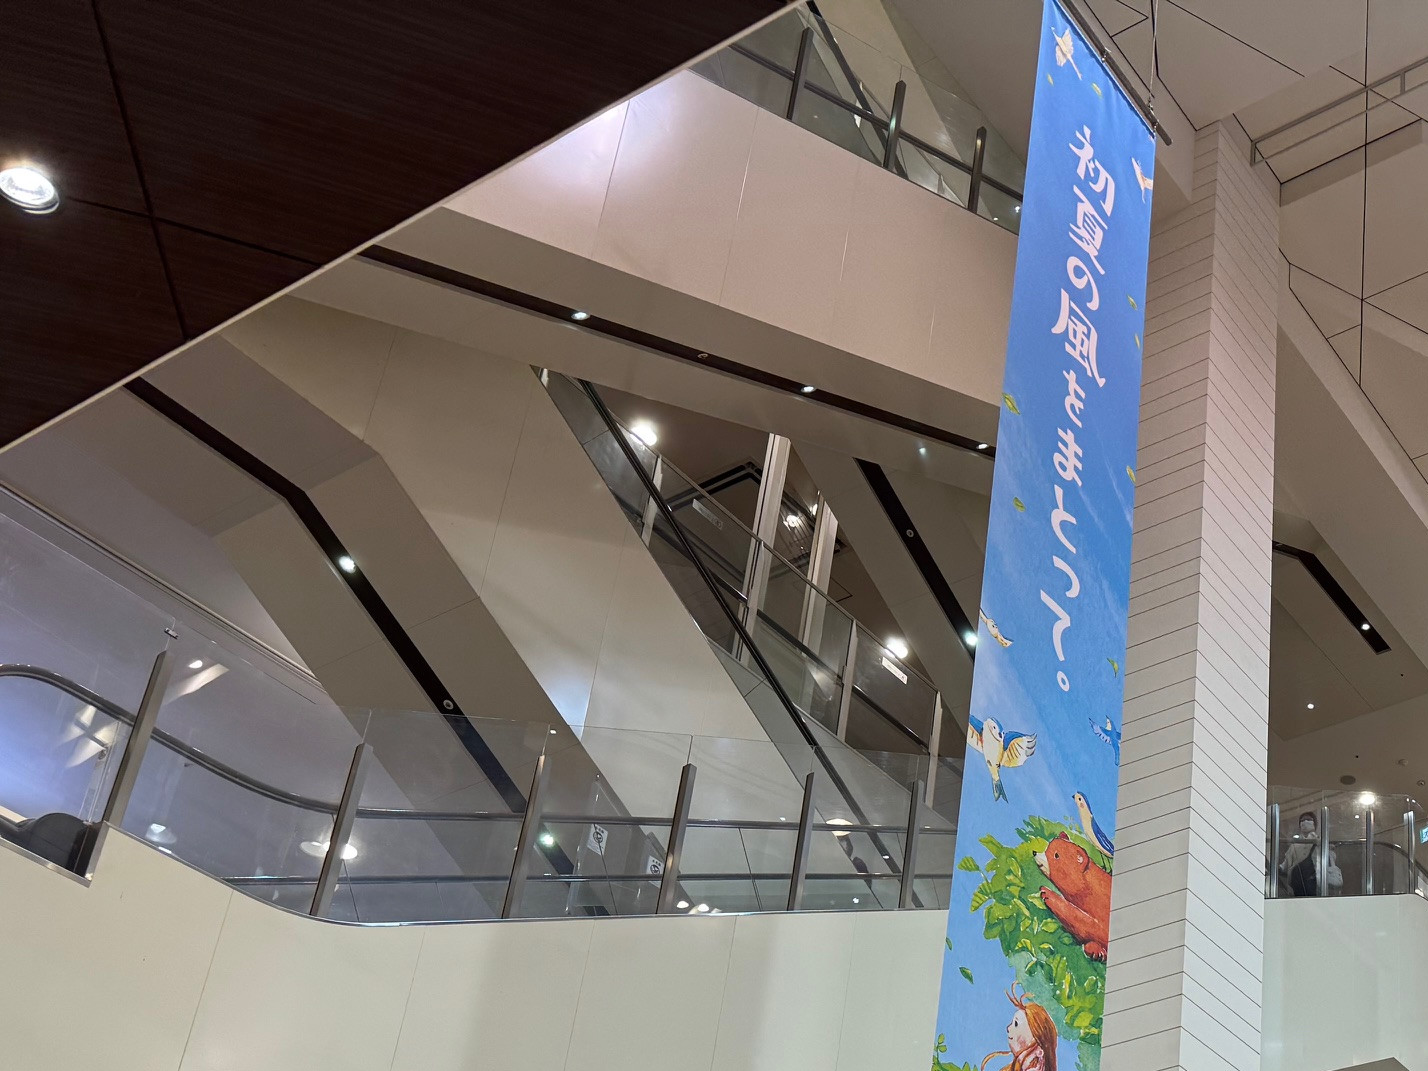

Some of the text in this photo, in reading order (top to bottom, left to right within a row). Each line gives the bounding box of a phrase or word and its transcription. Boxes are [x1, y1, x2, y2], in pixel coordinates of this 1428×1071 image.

[1039, 124, 1115, 692] 初夏の風をまとって。
